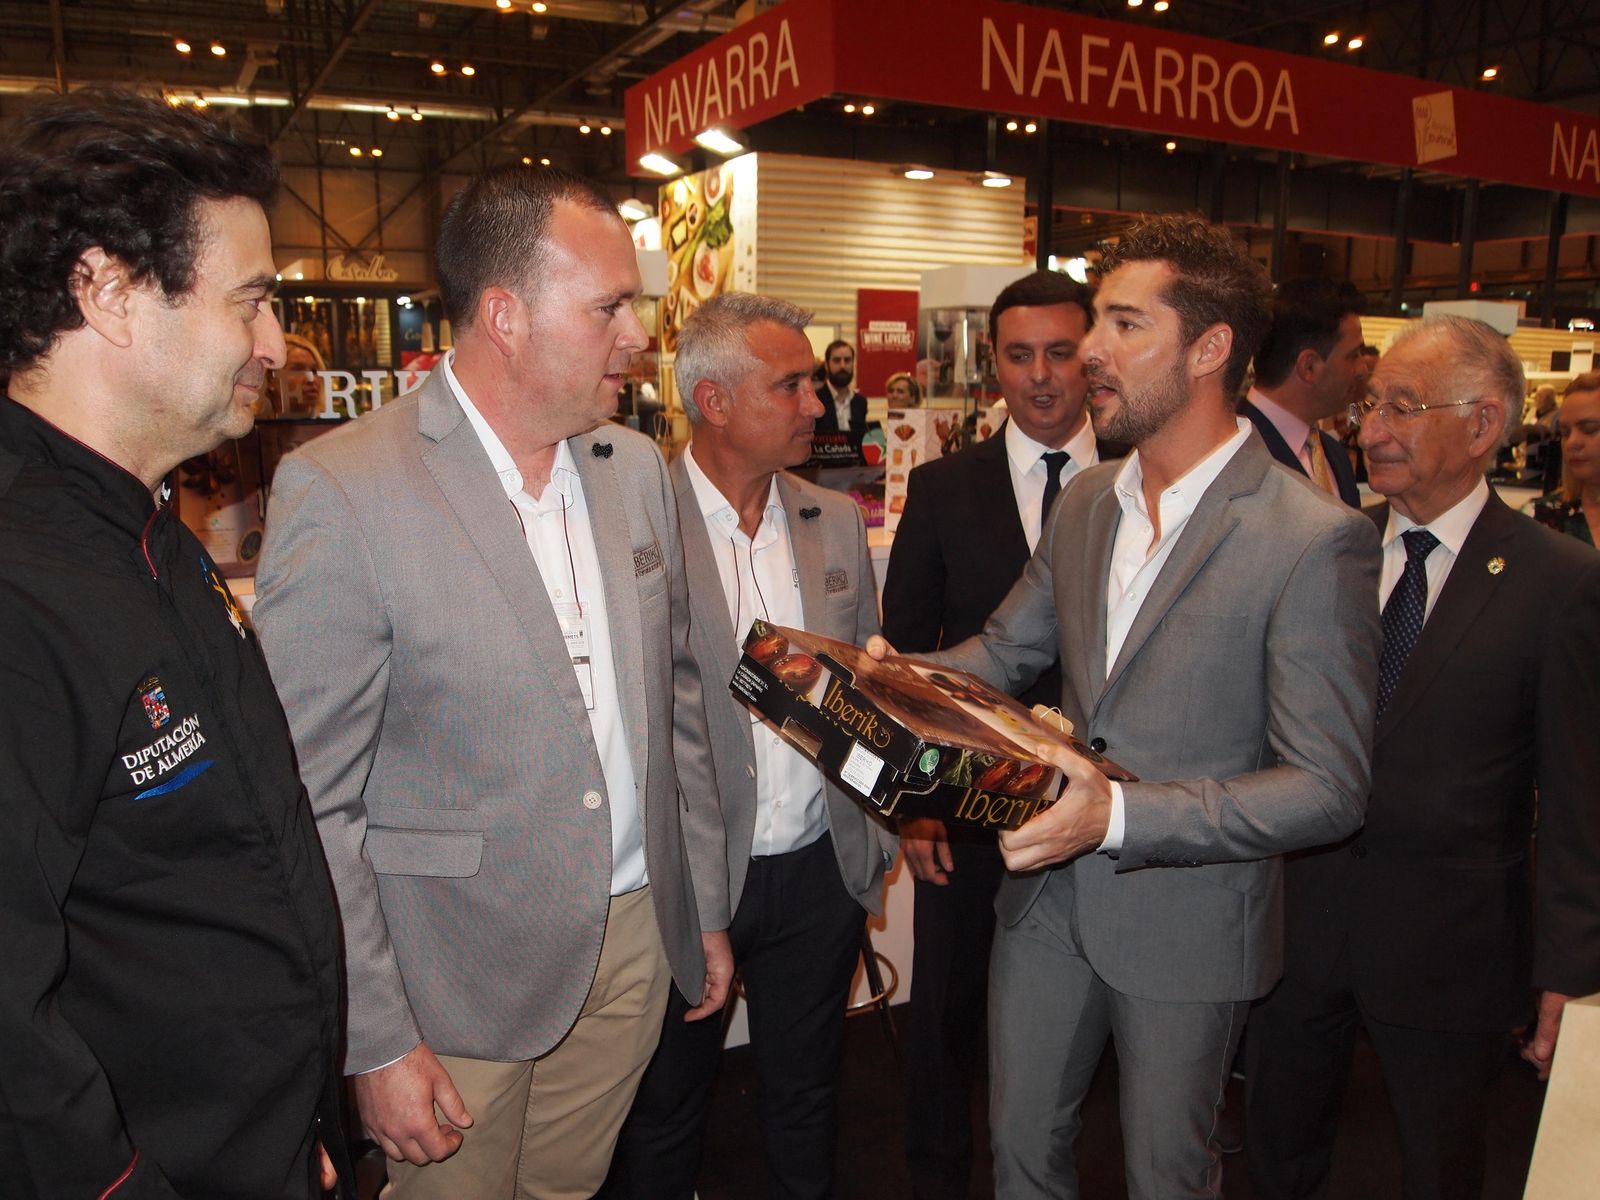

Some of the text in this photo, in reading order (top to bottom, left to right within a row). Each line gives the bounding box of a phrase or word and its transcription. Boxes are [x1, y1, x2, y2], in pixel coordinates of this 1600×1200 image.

[644, 18, 800, 151] NAVARRA
[981, 17, 1299, 135] NAFARROA
[121, 712, 201, 770] DIPUTACIÓN
[130, 732, 207, 786] DE ALMERÍA
